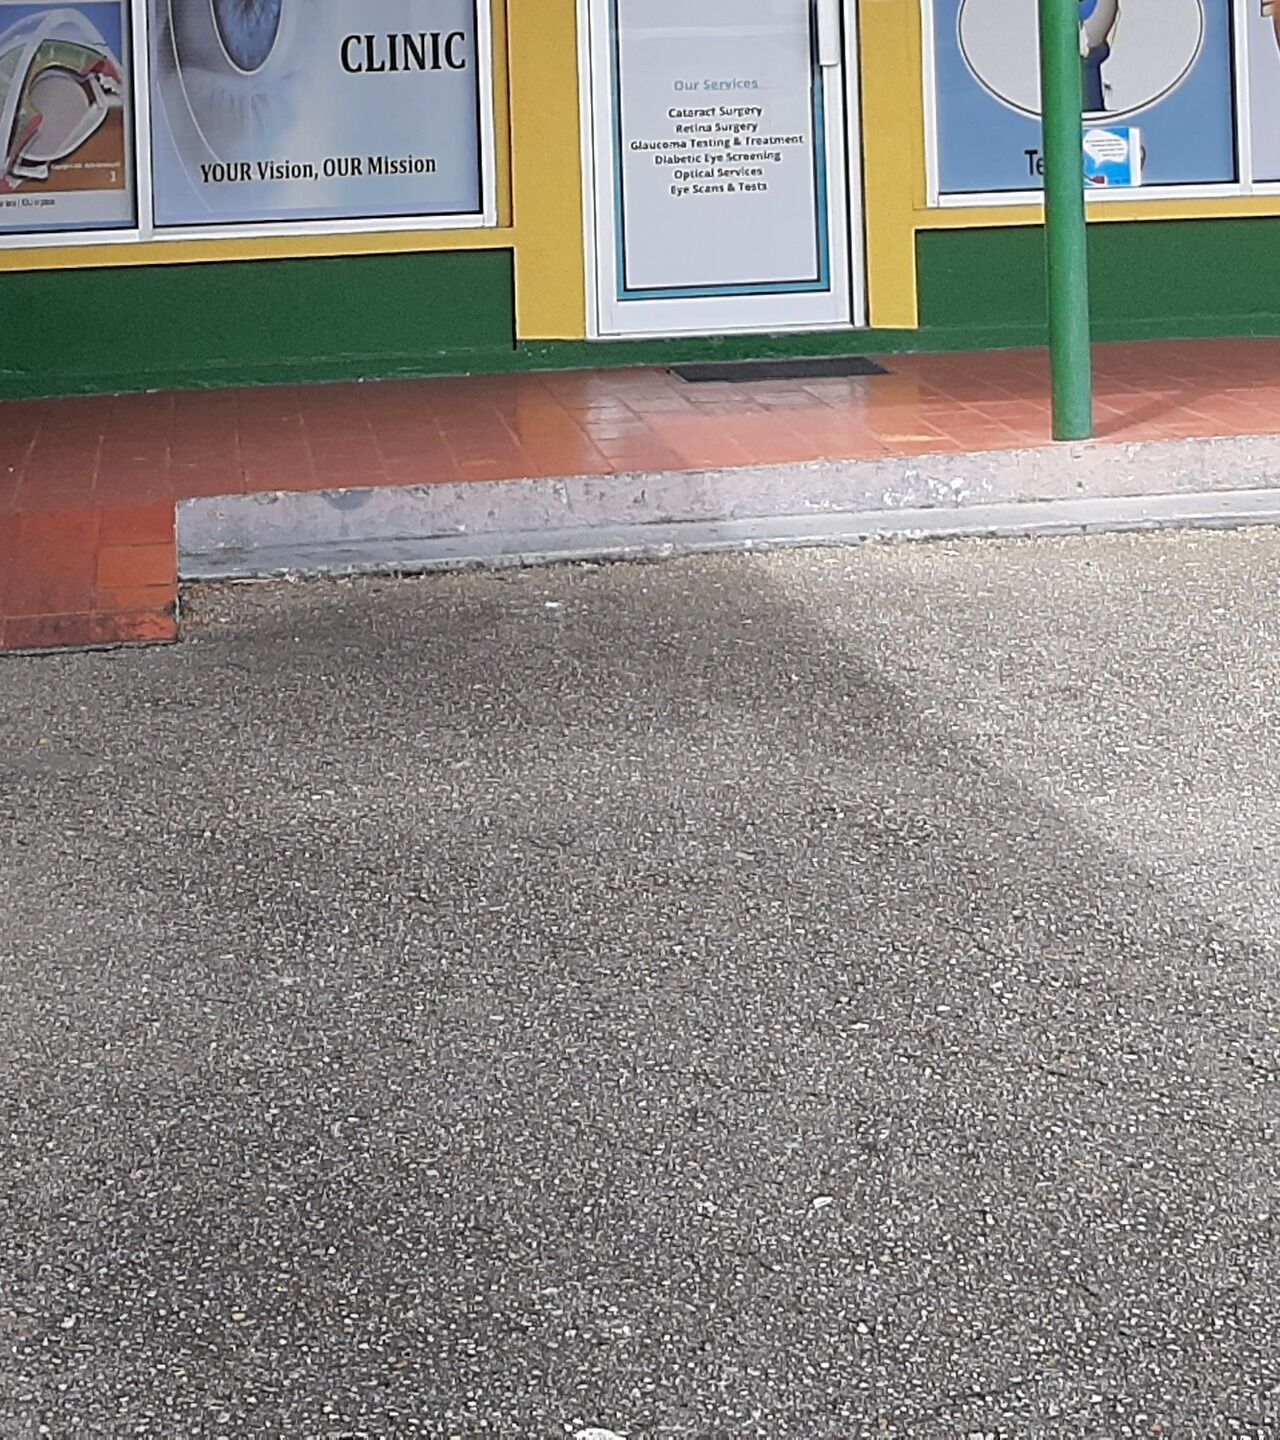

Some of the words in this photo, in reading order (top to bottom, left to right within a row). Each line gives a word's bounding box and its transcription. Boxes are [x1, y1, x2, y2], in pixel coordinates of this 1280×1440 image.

[341, 32, 466, 73] CLINIC
[674, 80, 698, 91] Our
[703, 78, 759, 90] Services
[668, 108, 715, 118] Cataract
[719, 107, 762, 118] Surgery
[676, 123, 712, 133] Retina
[715, 122, 758, 133] Surgery
[630, 140, 687, 151] Glaucoma
[690, 139, 730, 149] Testing
[733, 138, 741, 146] &
[745, 135, 804, 146] Treatment
[655, 154, 701, 165] Diabetic
[704, 154, 723, 165] Eye
[726, 151, 781, 162] Screening
[200, 162, 252, 183] YOUR
[257, 160, 319, 181] Vision,
[323, 157, 363, 177] OUR
[368, 154, 436, 175] Mission
[674, 168, 715, 181] Optical
[717, 167, 763, 178] Services
[671, 185, 690, 197] Eye
[692, 184, 724, 194] Scans
[727, 183, 735, 191] &
[738, 182, 768, 192] Tests
